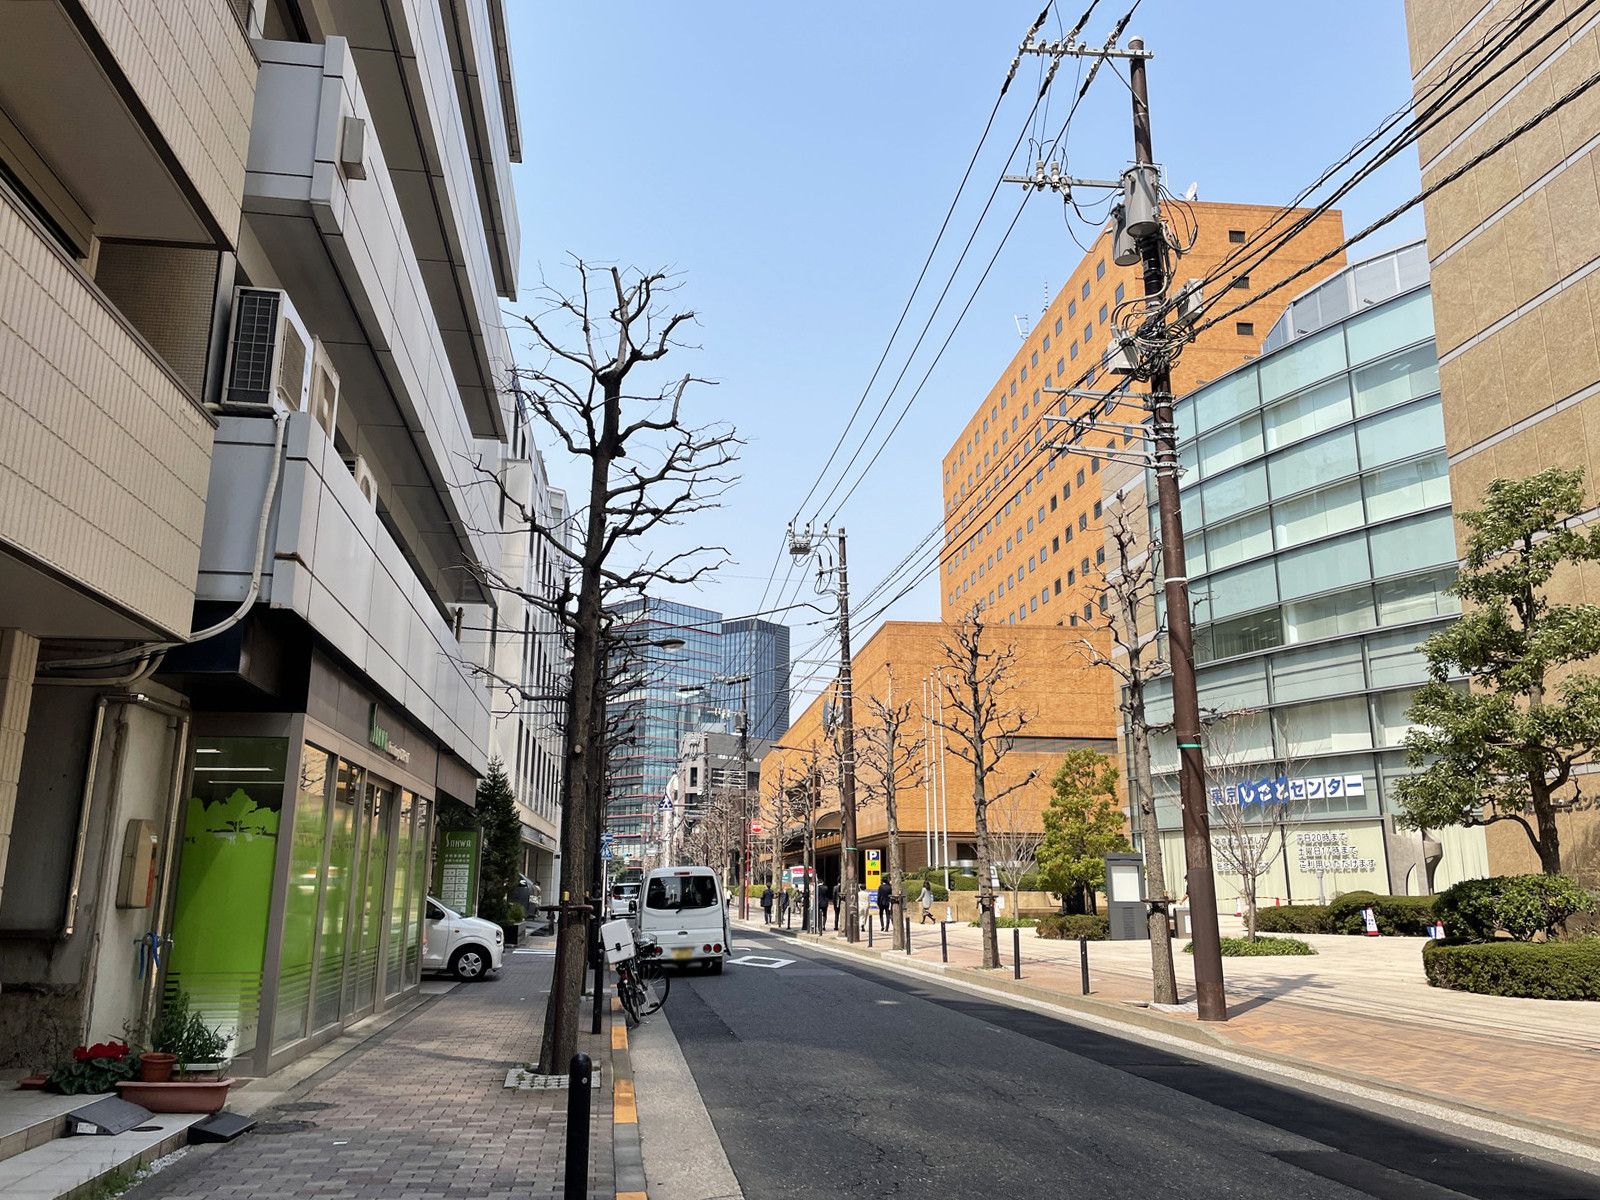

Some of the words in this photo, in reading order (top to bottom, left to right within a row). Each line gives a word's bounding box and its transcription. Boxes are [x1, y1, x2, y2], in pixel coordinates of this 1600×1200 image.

[1211, 778, 1362, 805] 東京しごとセンター
[869, 851, 877, 861] P
